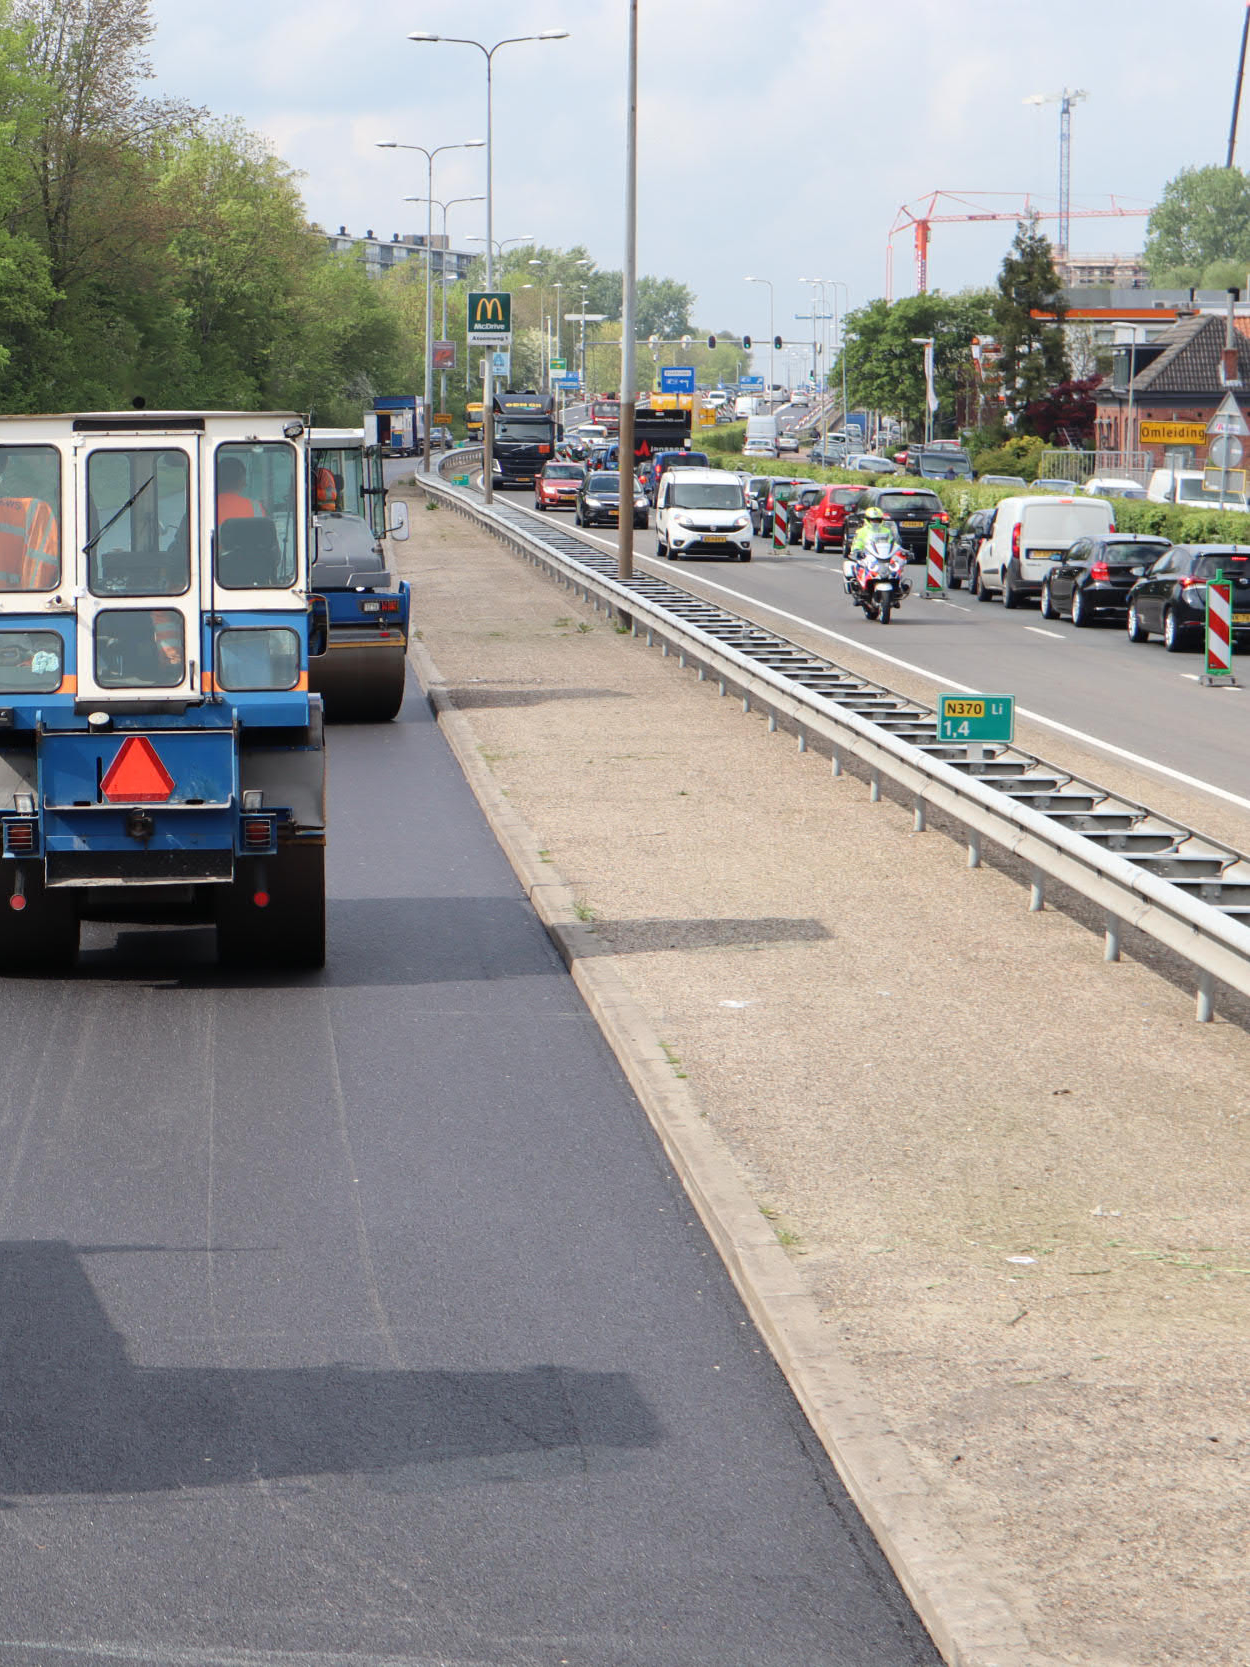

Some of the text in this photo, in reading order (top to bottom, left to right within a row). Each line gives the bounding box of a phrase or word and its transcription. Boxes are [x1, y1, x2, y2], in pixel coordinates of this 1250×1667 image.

[1141, 427, 1205, 440] Omleiding
[947, 703, 1003, 715] N370 Li
[943, 720, 970, 738] 1,4
